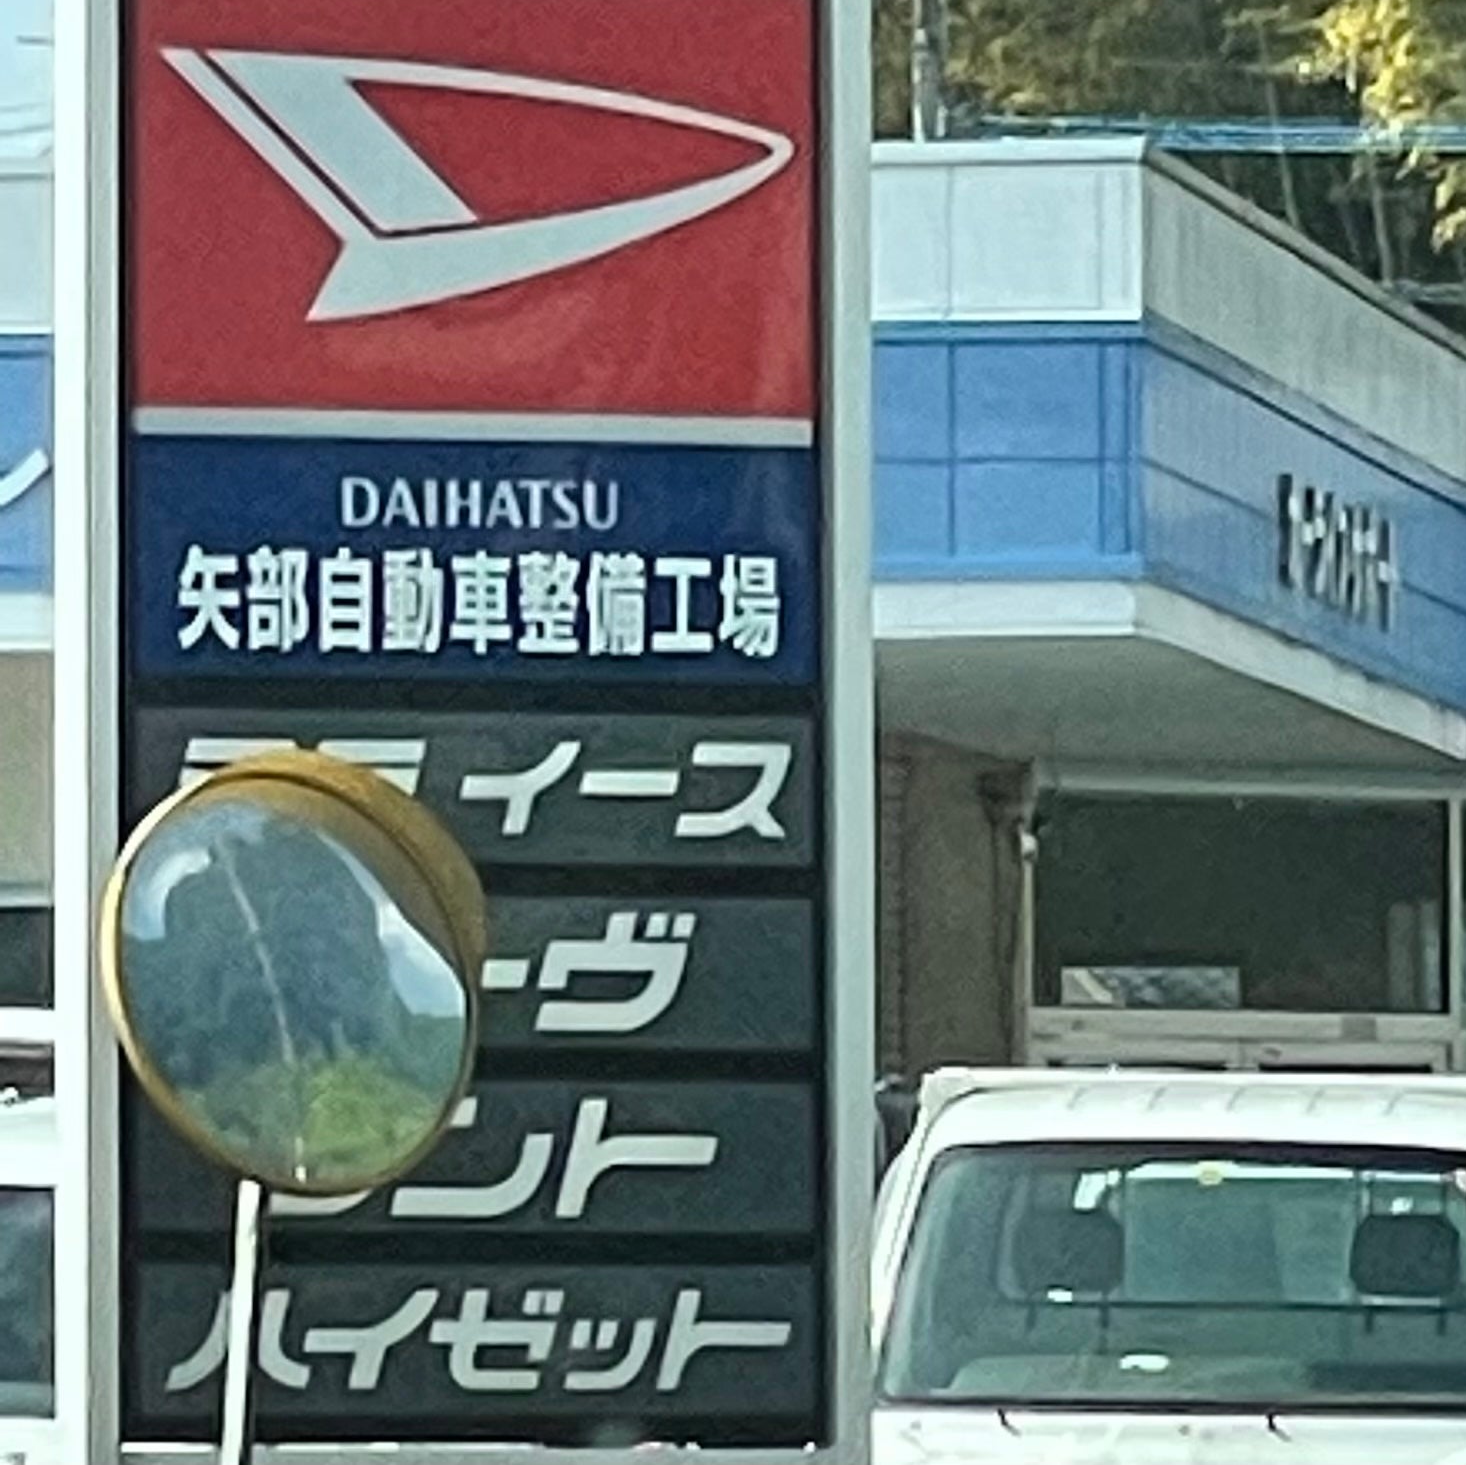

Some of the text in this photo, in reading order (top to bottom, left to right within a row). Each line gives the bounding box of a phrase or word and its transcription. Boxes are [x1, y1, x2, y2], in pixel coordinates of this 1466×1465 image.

[340, 477, 620, 530] DAIHATSU
[177, 544, 782, 657] 矢部自動車整備工場
[179, 737, 793, 838] イース
[164, 1289, 792, 1392] ハイゼット
